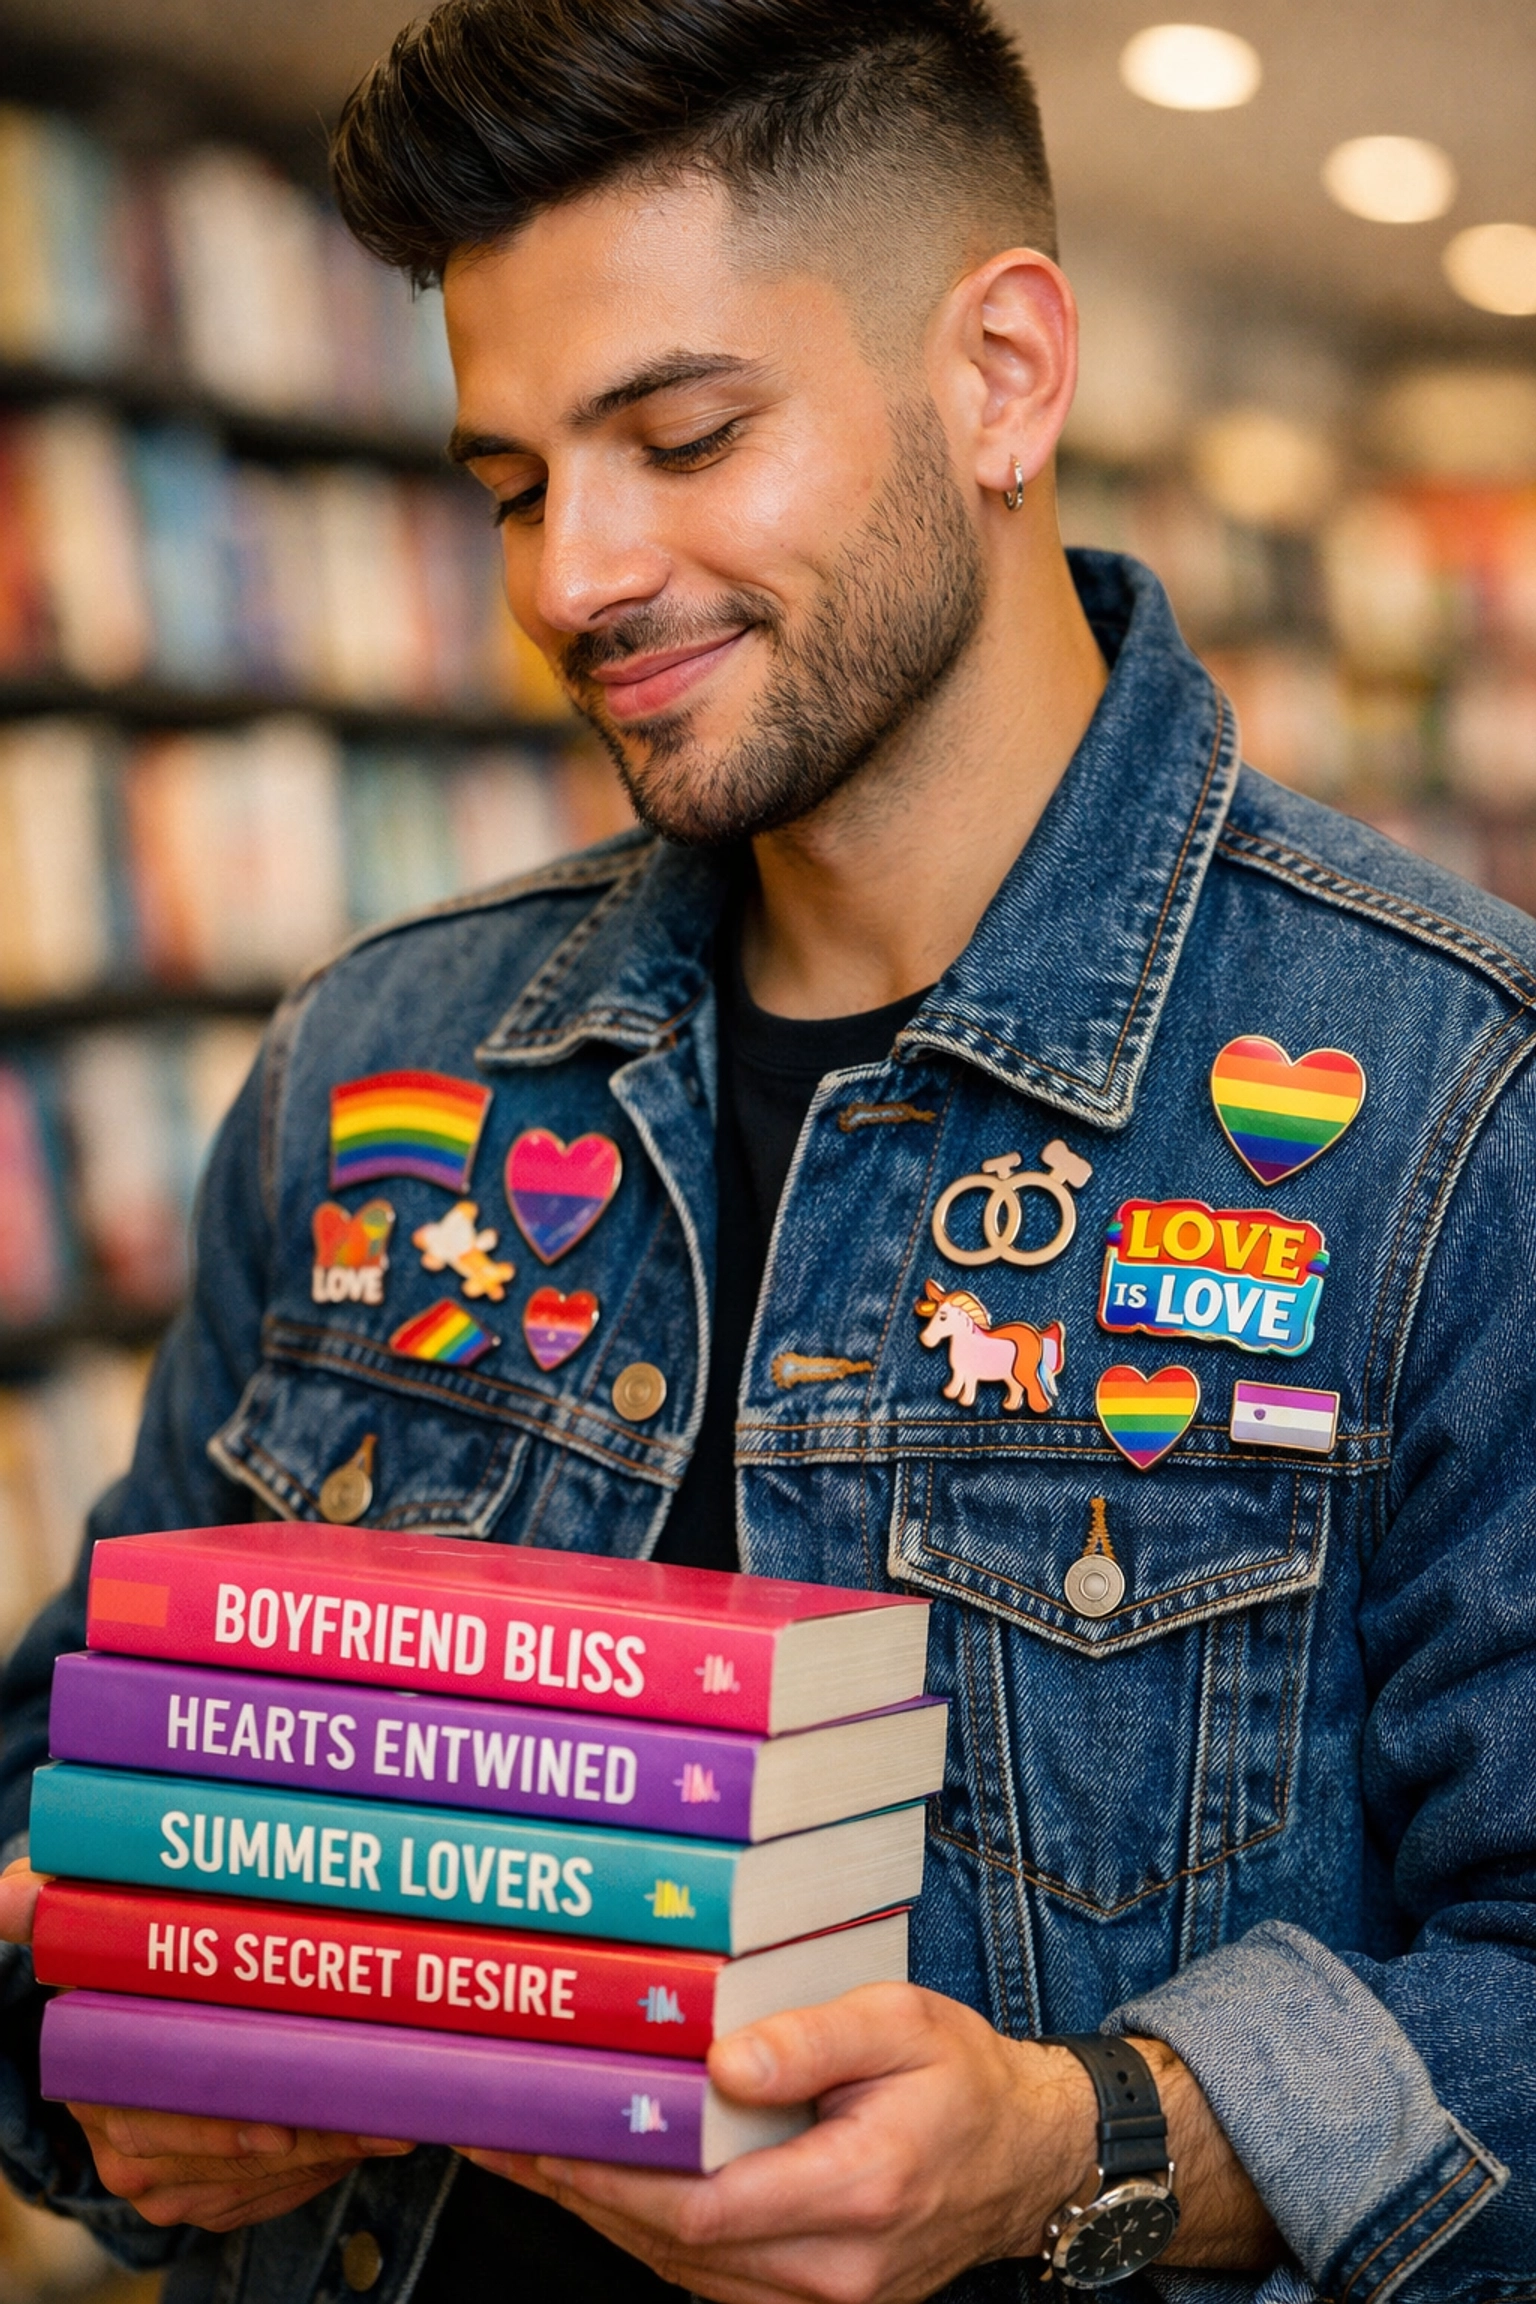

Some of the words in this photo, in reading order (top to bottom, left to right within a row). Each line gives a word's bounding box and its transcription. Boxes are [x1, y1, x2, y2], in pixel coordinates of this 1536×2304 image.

[313, 1267, 383, 1304] LOVE
[1126, 1208, 1306, 1279] LOVE
[1114, 1283, 1147, 1309] IS
[1155, 1274, 1296, 1341] LOVE
[215, 1583, 487, 1676] BOYFRIEND
[504, 1620, 646, 1698] BLISS
[167, 1694, 357, 1771] HEARTS
[374, 1719, 637, 1805] ENTWINED
[160, 1810, 382, 1891] SUMMER
[400, 1837, 594, 1917] LOVERS
[147, 1922, 219, 1977] HIS
[234, 1933, 401, 1998] SECRET
[416, 1953, 577, 2020] DESIRE
